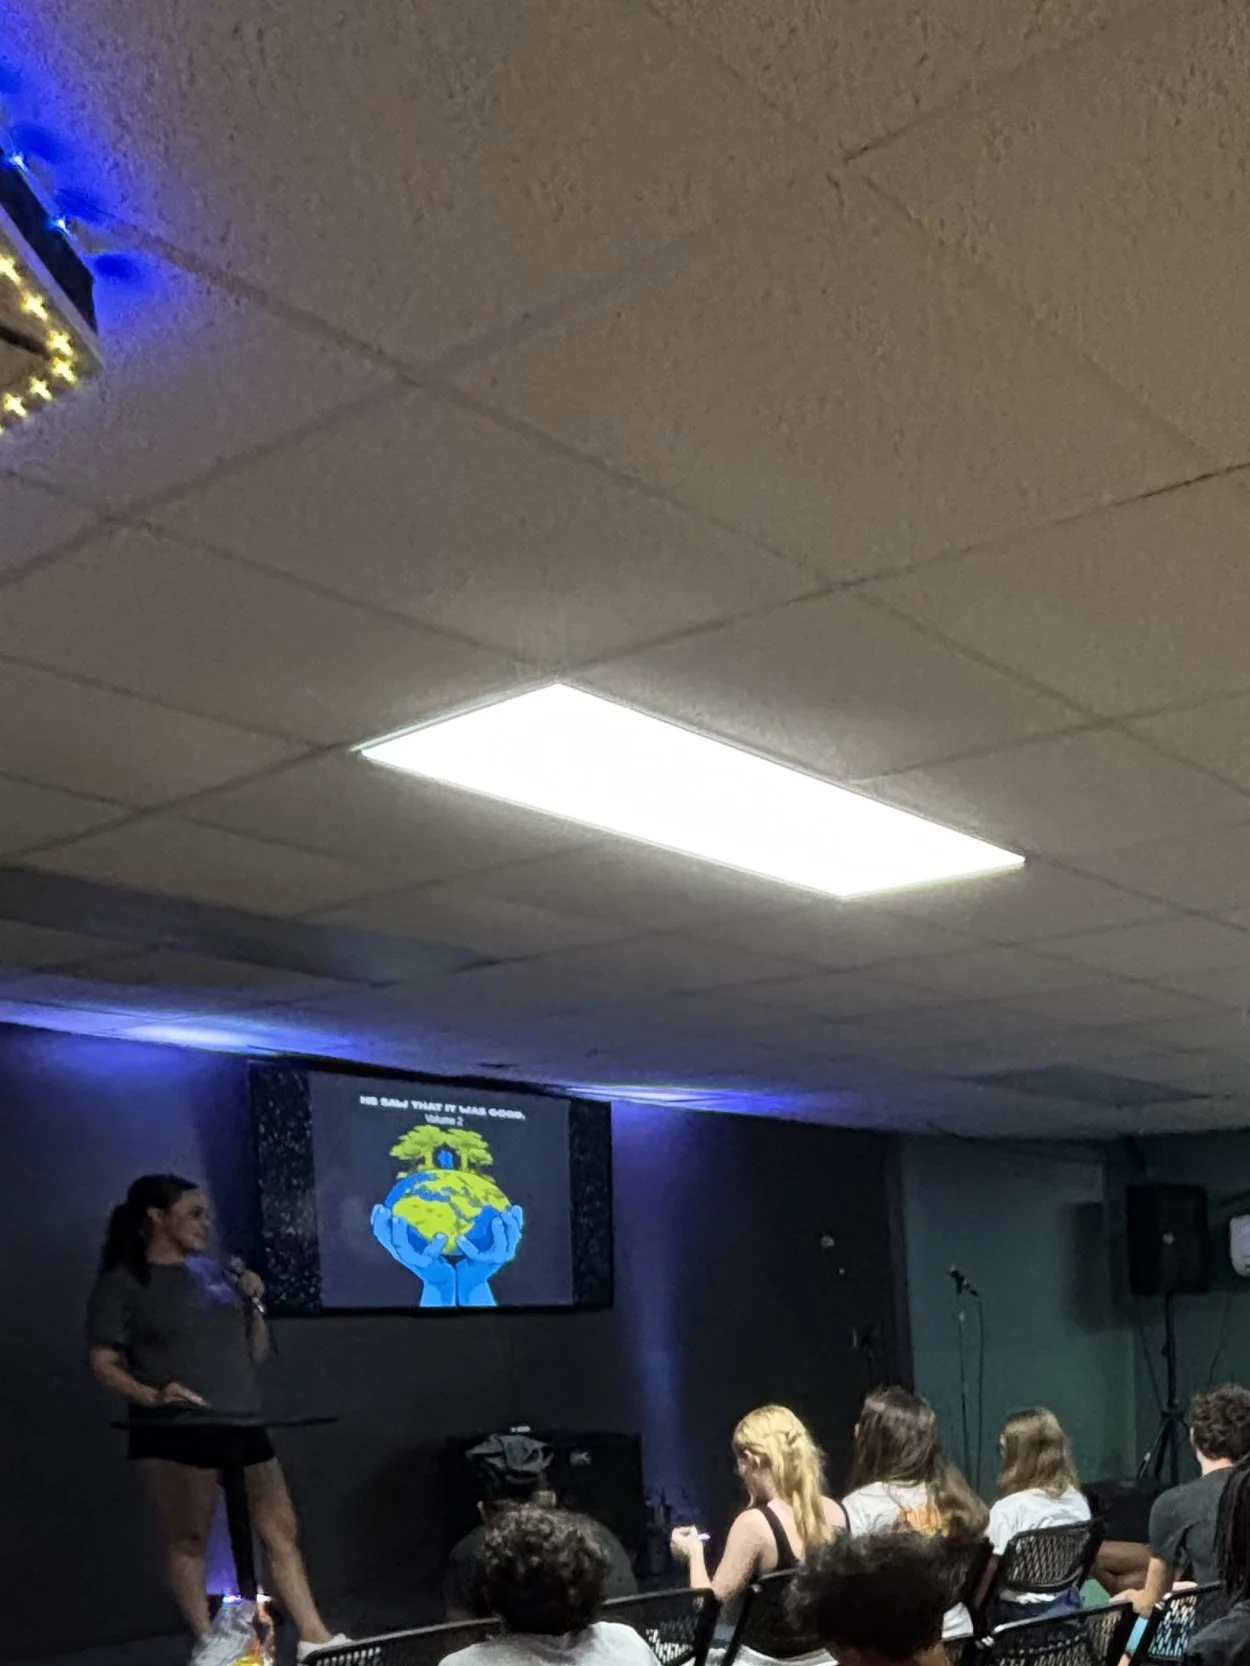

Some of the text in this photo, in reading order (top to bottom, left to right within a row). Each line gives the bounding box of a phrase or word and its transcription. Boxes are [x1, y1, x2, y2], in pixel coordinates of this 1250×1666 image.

[380, 1097, 408, 1109] SAW
[411, 1100, 443, 1111] THAT
[445, 1104, 456, 1113] IT
[459, 1105, 487, 1116] WAS
[425, 1113, 464, 1127] Volume 2
